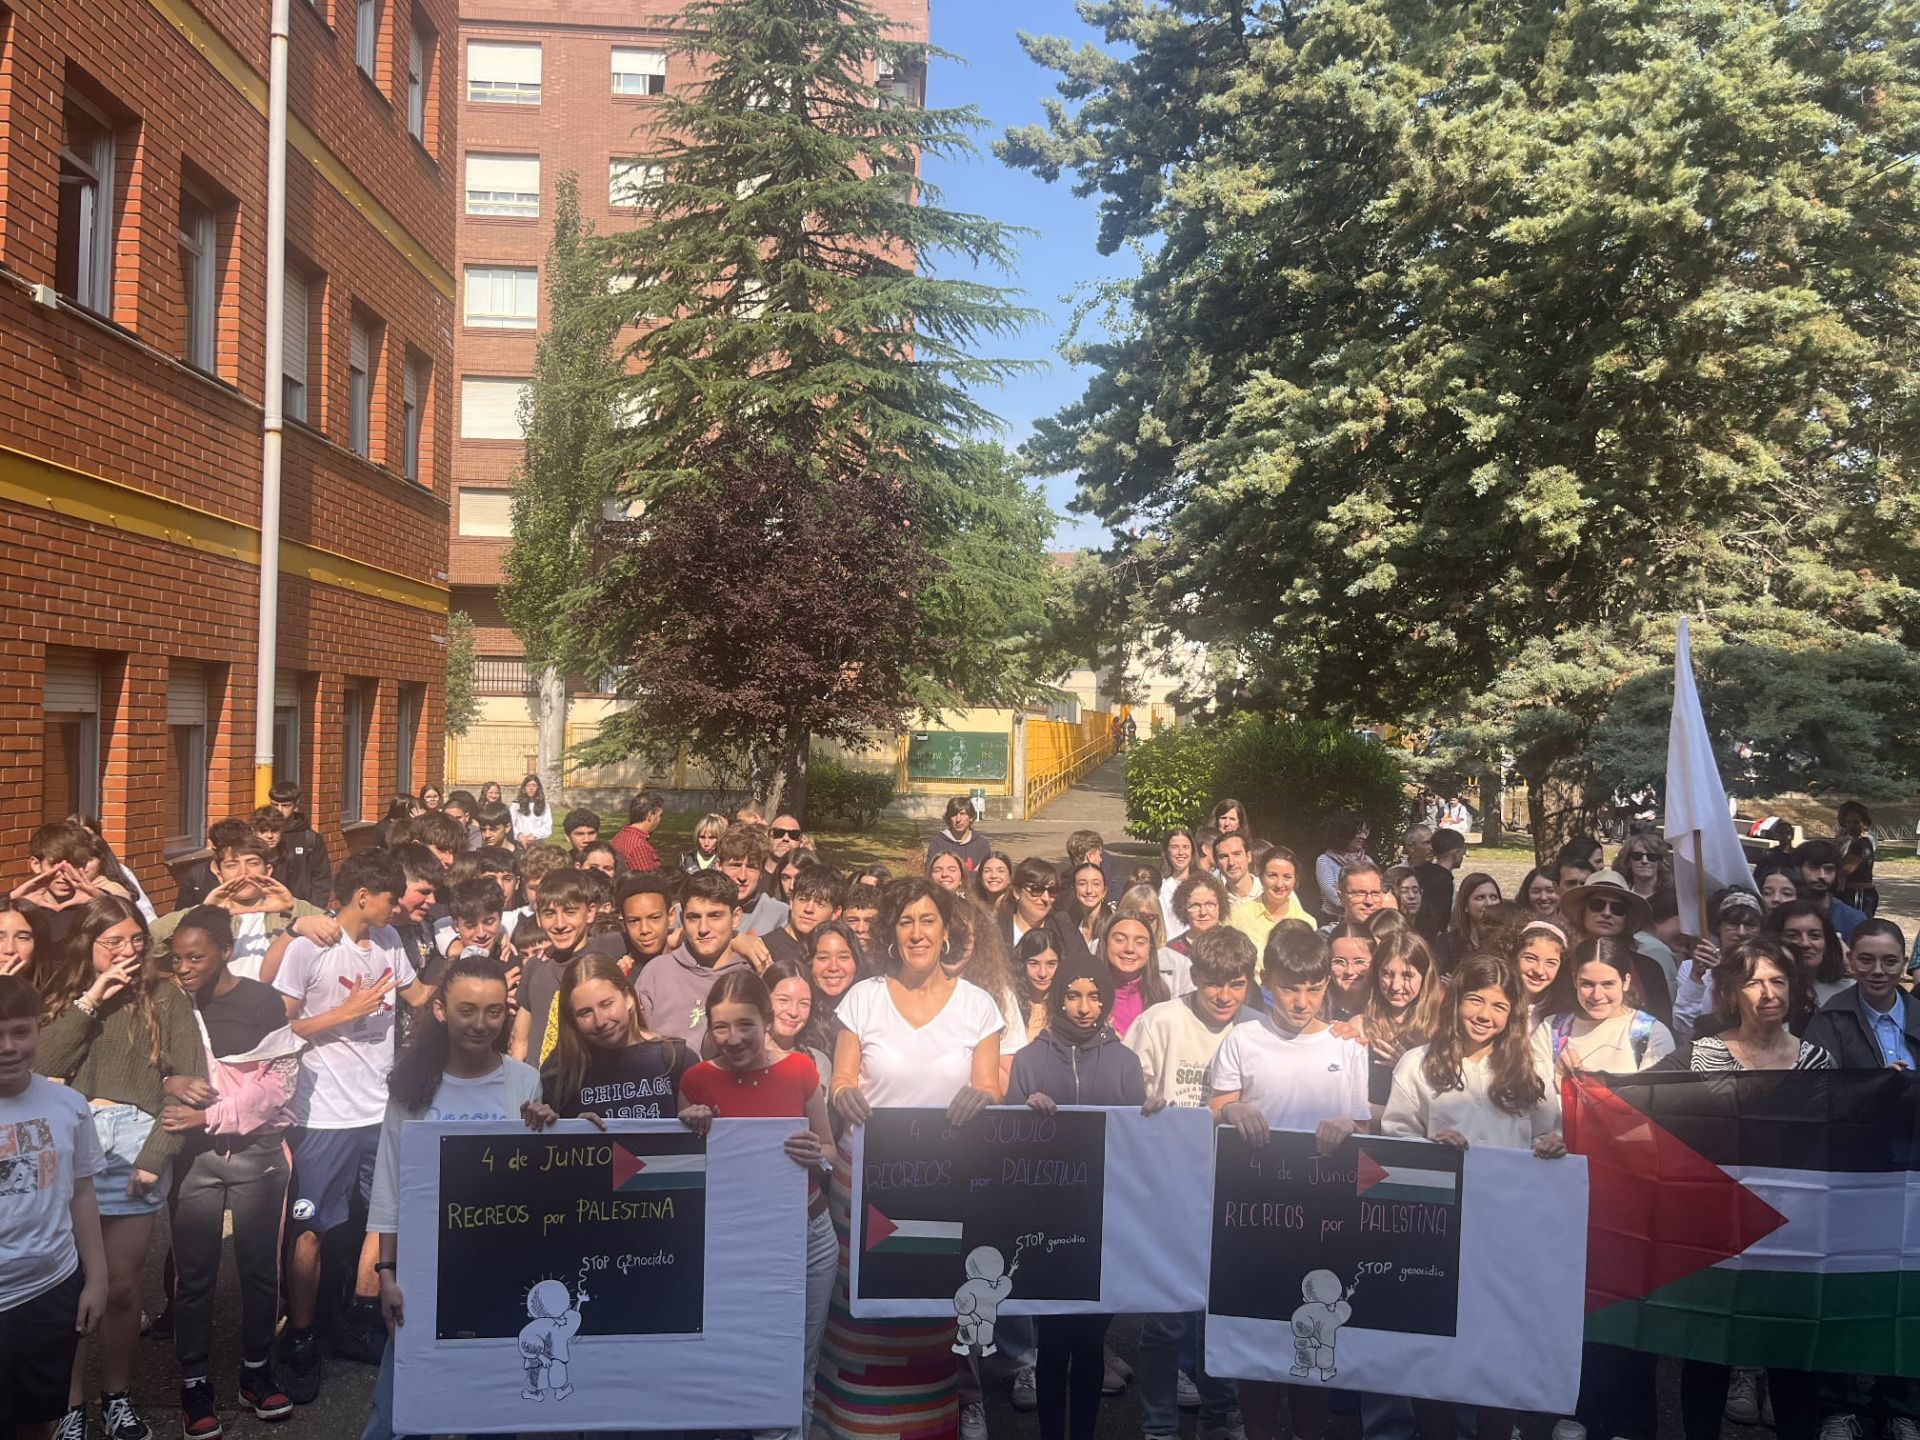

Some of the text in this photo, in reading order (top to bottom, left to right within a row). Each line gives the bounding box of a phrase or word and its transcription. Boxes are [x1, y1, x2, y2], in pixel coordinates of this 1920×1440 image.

[605, 1102, 661, 1119] 1964
[909, 1119, 920, 1139] 4
[942, 1125, 961, 1141] de
[482, 1145, 494, 1173] 4
[508, 1147, 529, 1172] de
[1249, 1154, 1358, 1186] 4 de Junio
[865, 1158, 1088, 1194] RECREOS por PALESTINA
[447, 1196, 676, 1238] RECREOS por PALESTINA
[1225, 1201, 1305, 1231] RECREOS
[1320, 1219, 1345, 1244] por
[1015, 1232, 1086, 1253] STOP genocidio
[582, 1254, 611, 1271] STOP
[1356, 1261, 1446, 1282] STOP genocidio
